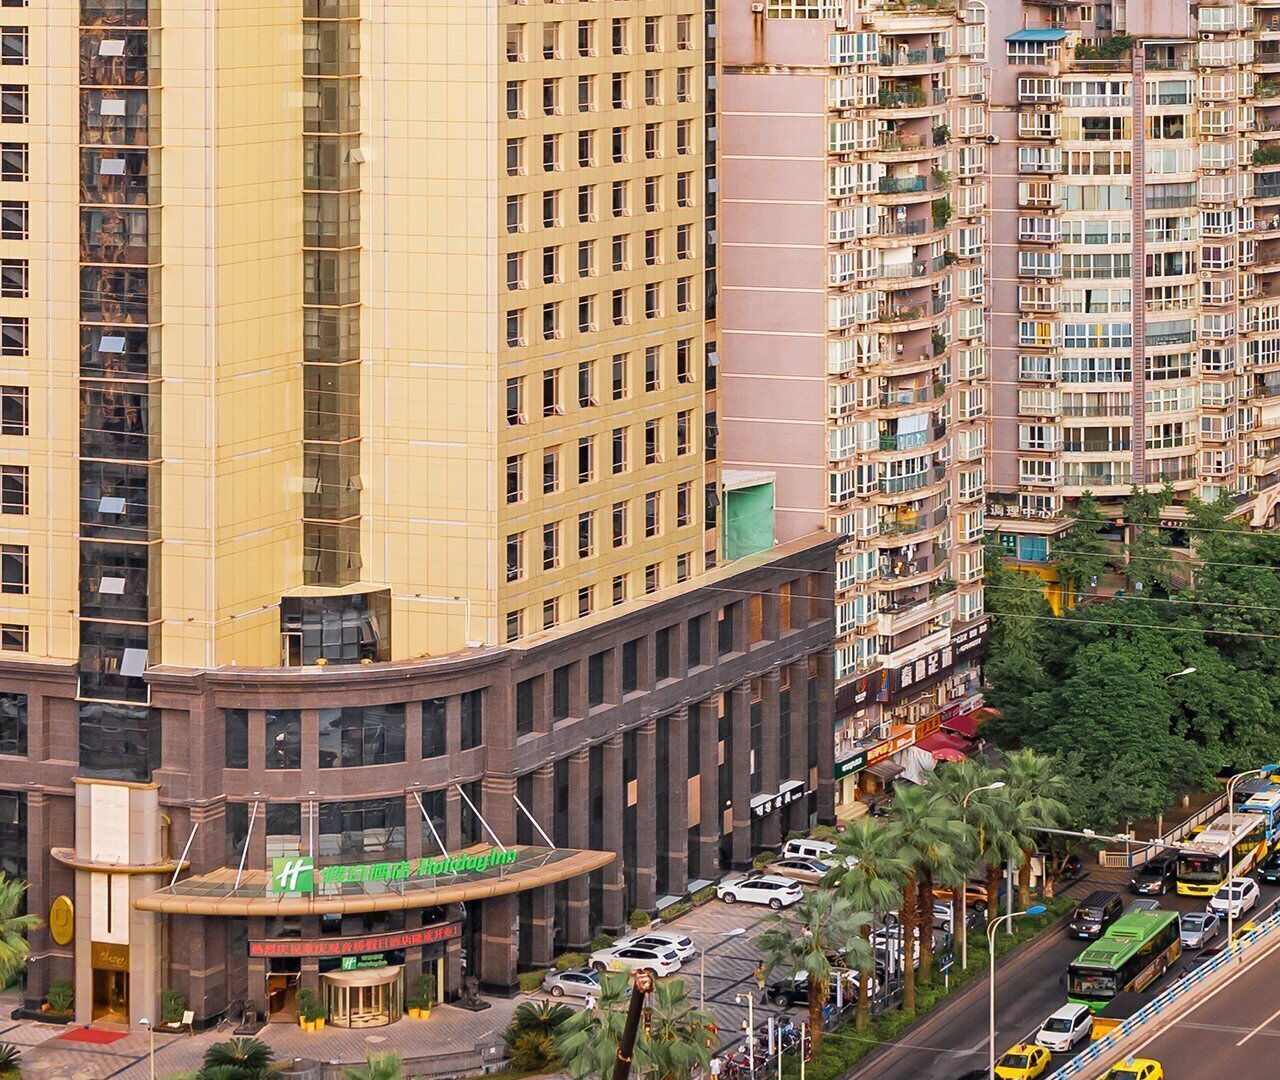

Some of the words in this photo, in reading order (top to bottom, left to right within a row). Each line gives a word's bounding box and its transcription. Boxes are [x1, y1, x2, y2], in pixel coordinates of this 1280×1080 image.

[320, 861, 412, 883] 假日酒店
[417, 852, 489, 877] Holiday
[489, 847, 517, 866] Inn
